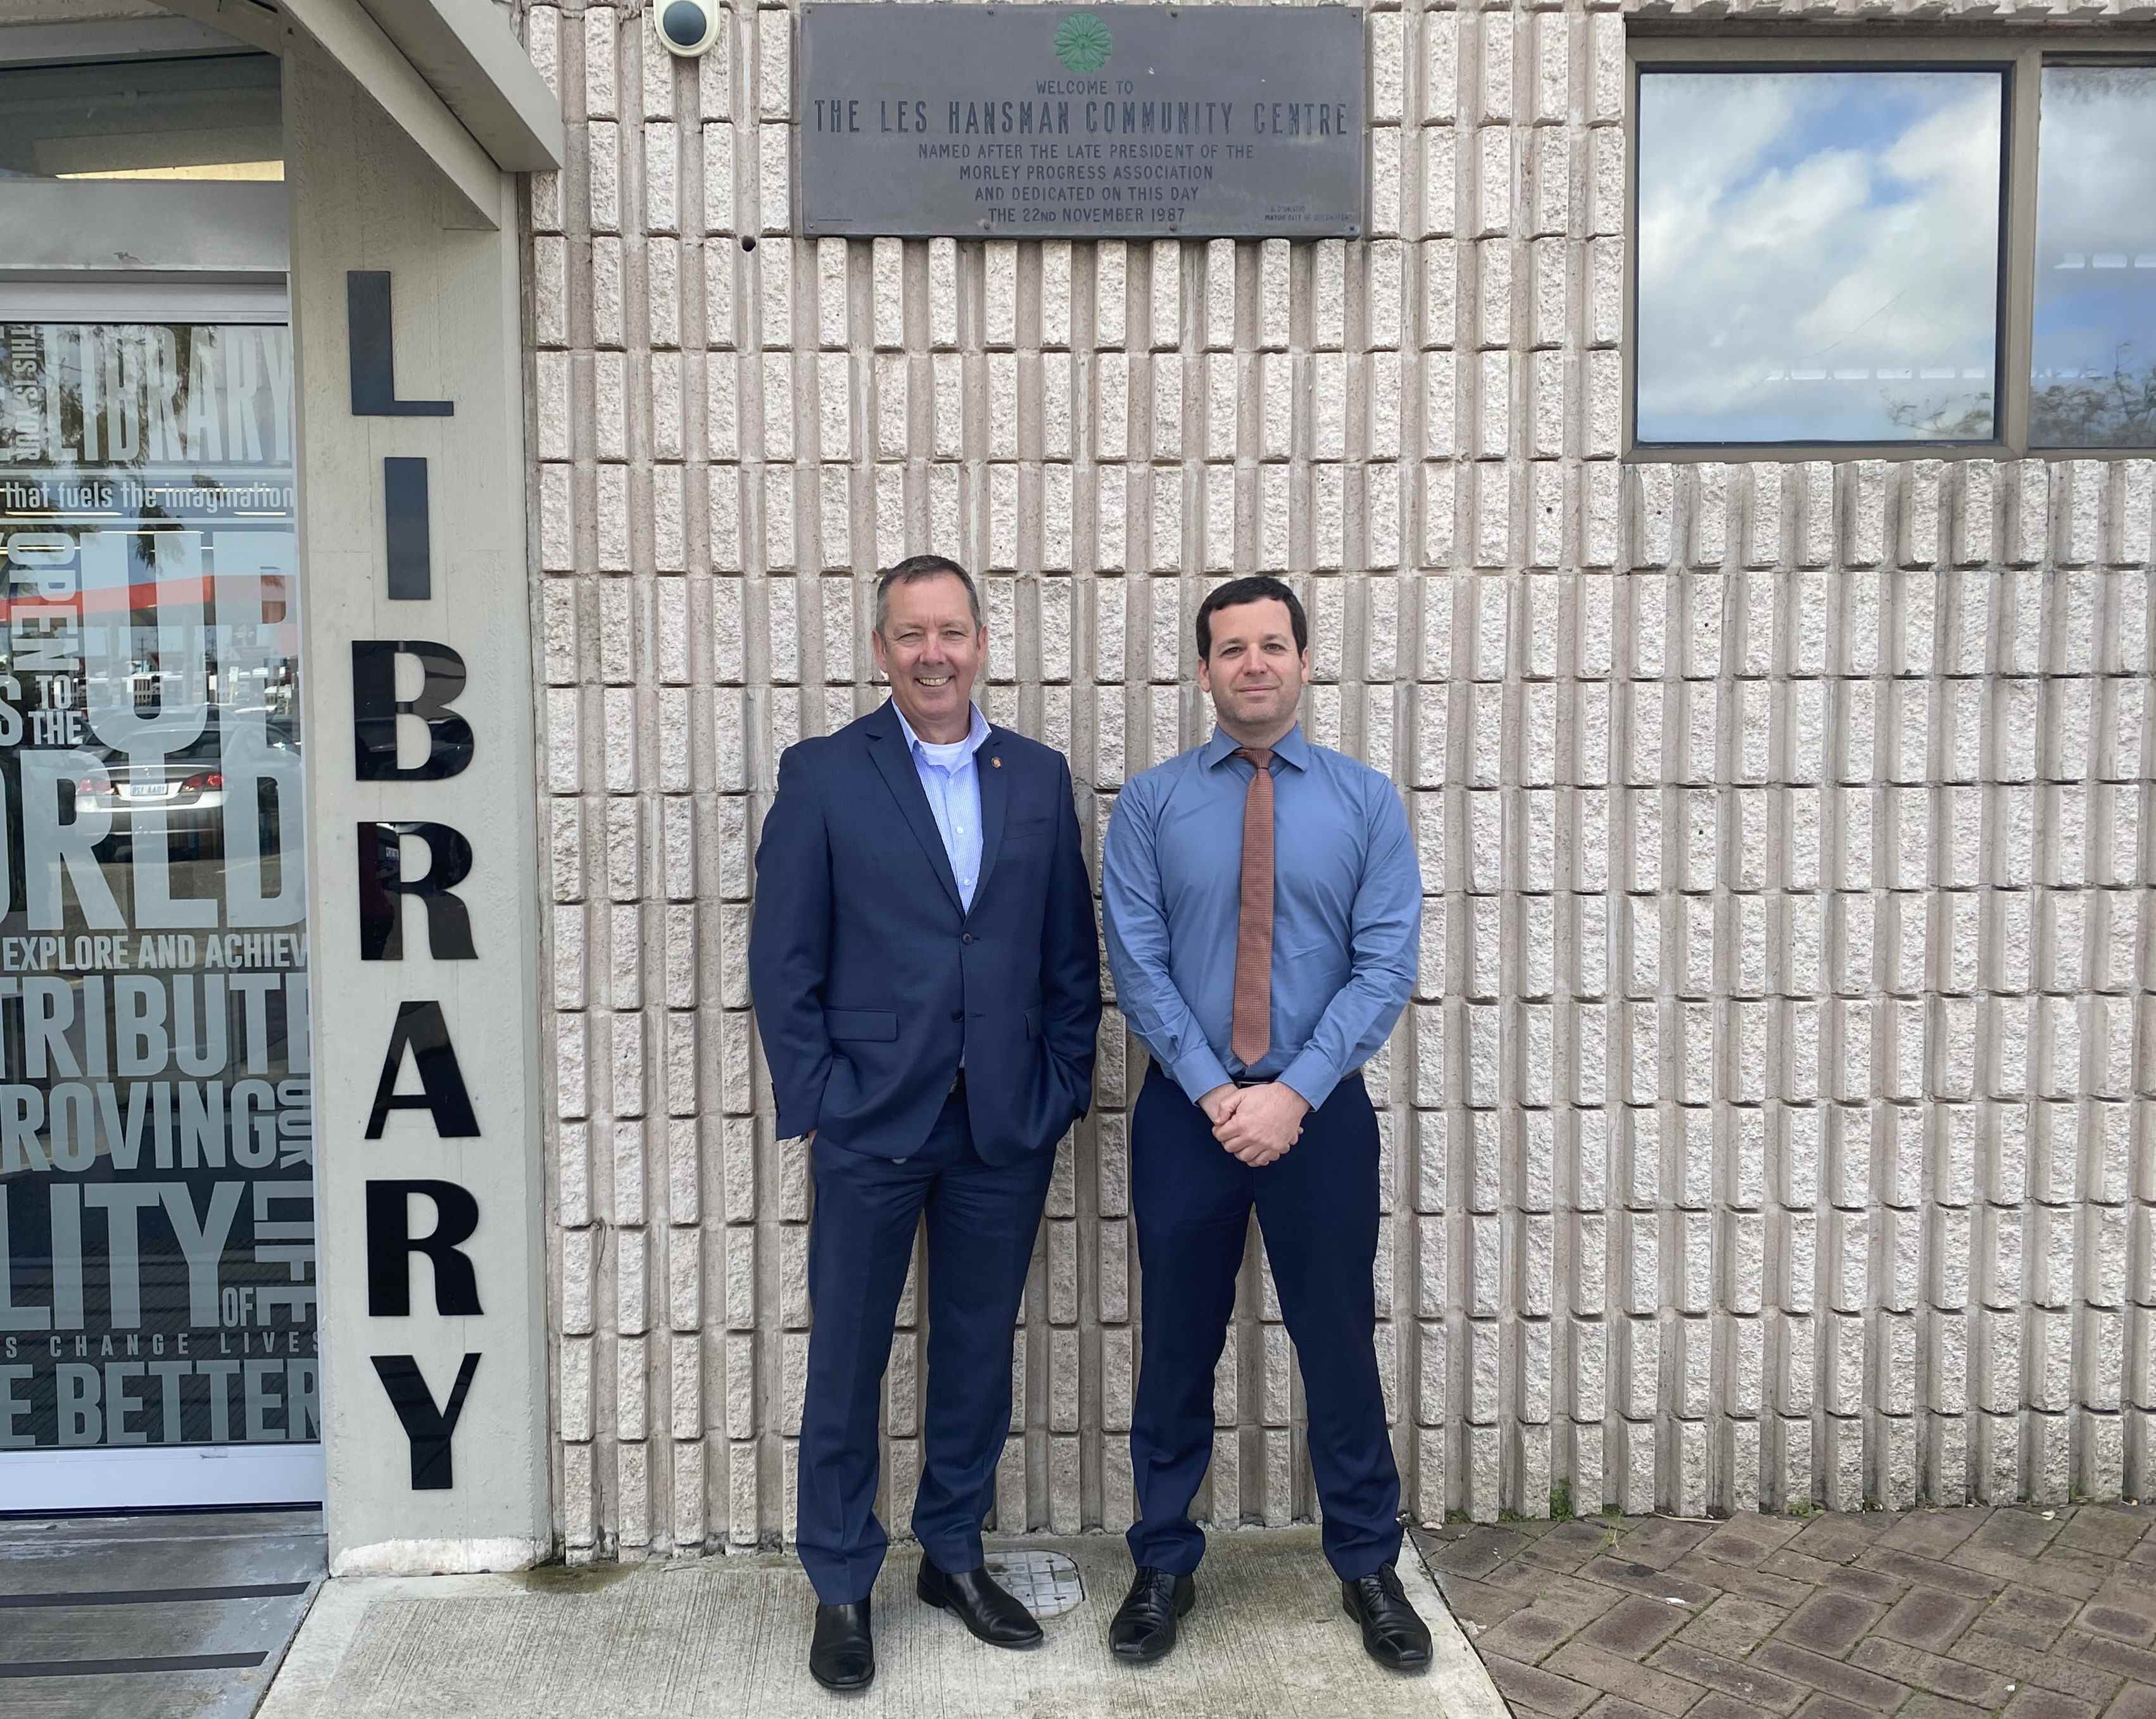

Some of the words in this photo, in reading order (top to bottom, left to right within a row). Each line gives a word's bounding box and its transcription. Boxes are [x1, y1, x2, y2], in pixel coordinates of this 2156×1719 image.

[1036, 80, 1107, 94] WELCOME
[1115, 80, 1133, 94] TO
[814, 100, 860, 133] THE
[881, 101, 927, 134] LES
[949, 101, 1069, 134] HANSMAN
[1086, 101, 1233, 135] COMMUNITY
[1254, 103, 1347, 135] CENTRE
[919, 144, 970, 159] NAMED
[977, 144, 1023, 159] AFTER
[1030, 144, 1058, 159] THE
[1067, 144, 1101, 159] LATE
[1110, 144, 1193, 159] PRESIDENT
[1201, 144, 1218, 159] OF
[1226, 144, 1254, 159] THE
[960, 165, 1021, 180] MORLEY
[1027, 165, 1106, 180] PROGRESS
[1113, 165, 1213, 180] ASSOCIATION
[975, 187, 1004, 201] AND
[1012, 187, 1095, 201] DEDICATED
[1102, 187, 1121, 201] ON
[1128, 187, 1163, 201] THIS
[1171, 187, 1199, 201] DAY
[989, 208, 1016, 223] THE
[1062, 208, 1144, 223] NOVEMBER
[1152, 208, 1185, 223] 1987
[11, 326, 37, 372] THIS
[13, 380, 38, 401] IS
[42, 325, 293, 462] LIBRARY
[5, 482, 50, 508] that
[58, 482, 113, 508] fuels
[120, 482, 157, 508] the
[165, 482, 294, 513] imagination
[8, 532, 79, 671] OPEN
[79, 531, 299, 755] UP
[35, 675, 72, 709] TO
[28, 711, 83, 745] THE
[0, 750, 307, 930] RLD
[347, 271, 484, 1489] LIBRARY
[3, 936, 129, 971] EXPLORE
[137, 934, 196, 969] AND
[253, 1180, 316, 1326] LIFE
[222, 1287, 253, 1327] OF
[50, 1333, 189, 1357] CHANGE
[56, 1357, 320, 1445] BETTER
